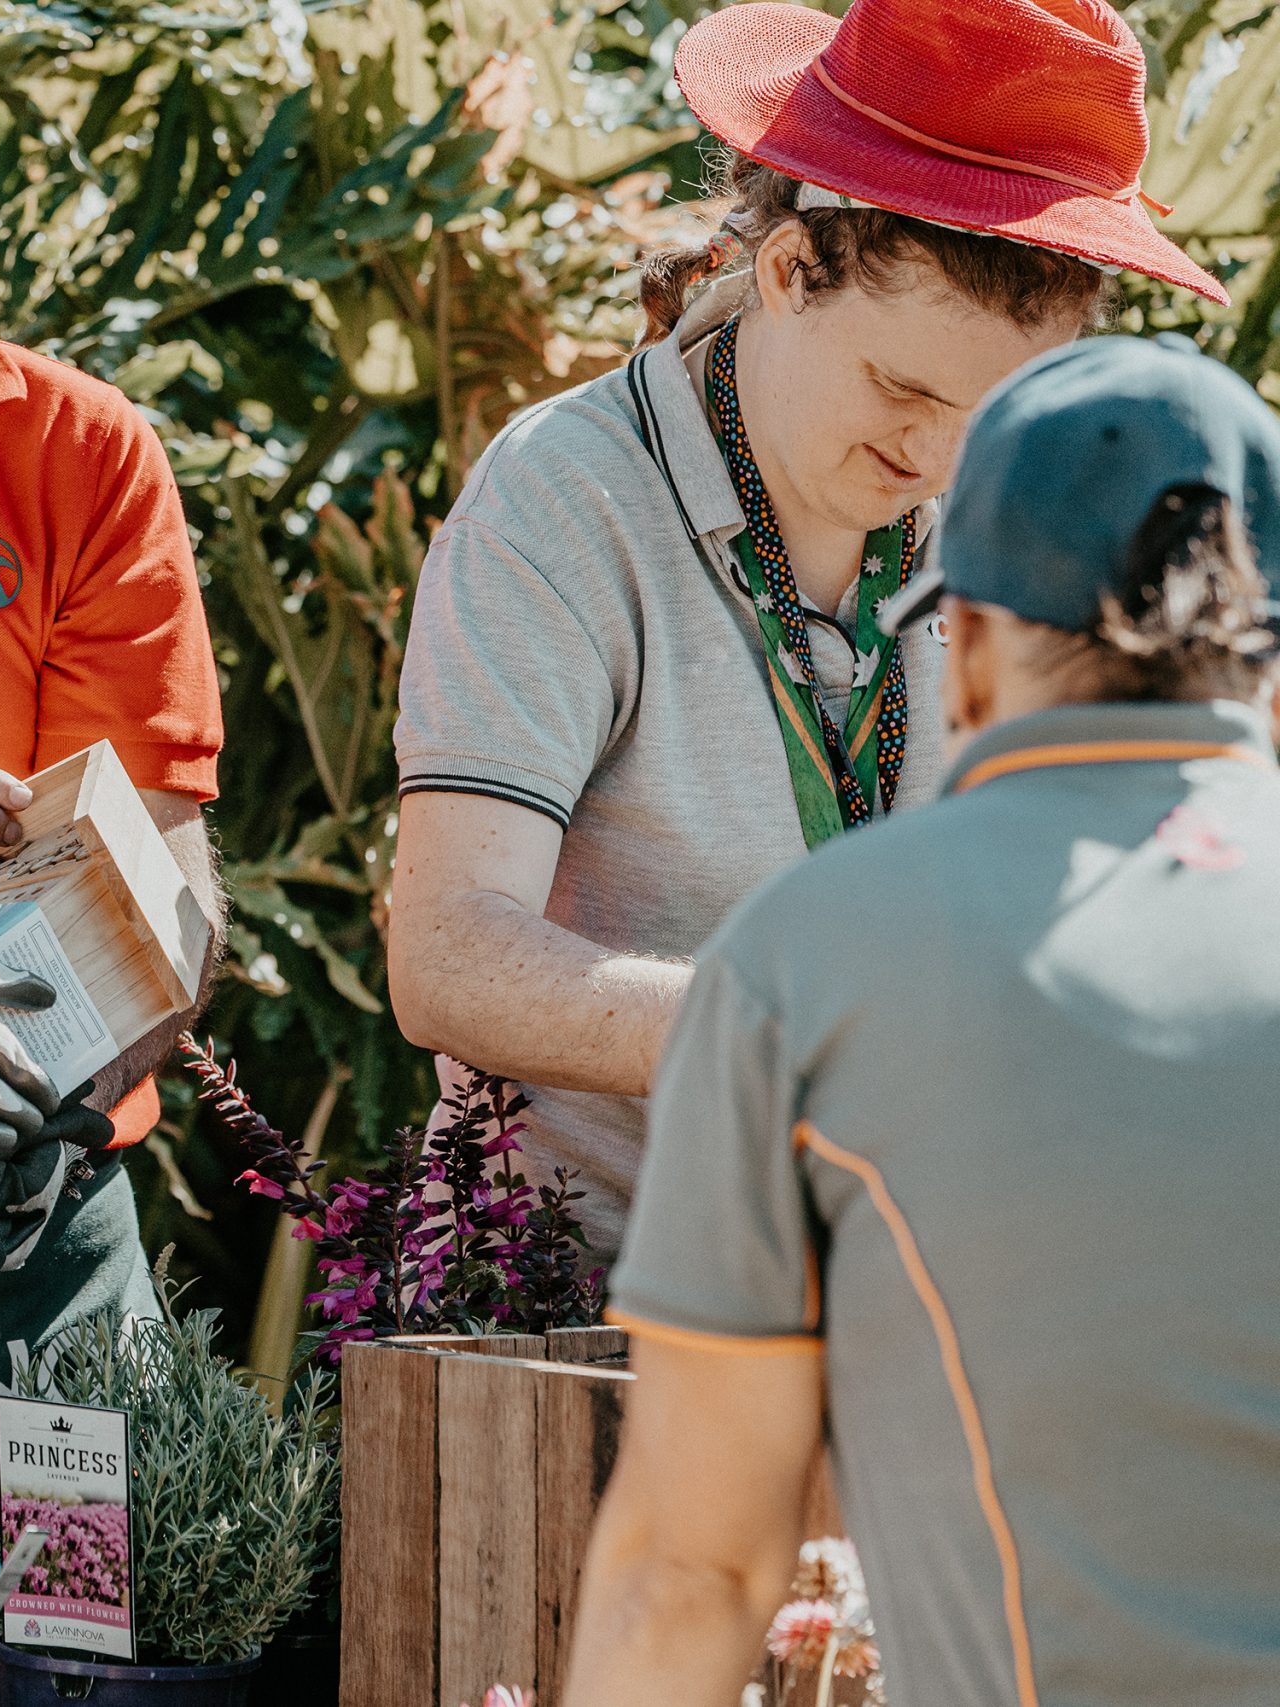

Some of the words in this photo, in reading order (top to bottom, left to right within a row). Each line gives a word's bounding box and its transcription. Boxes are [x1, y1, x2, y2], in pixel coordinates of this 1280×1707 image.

[49, 959, 60, 973] DID
[56, 972, 68, 988] YOU
[65, 987, 81, 1010] KNOW
[44, 1029, 63, 1058] providing
[55, 1436, 69, 1445] THE
[8, 1440, 118, 1477] PRINCESS
[9, 1599, 56, 1611] CROWNED
[59, 1603, 83, 1614] WITH
[86, 1607, 126, 1622] FLOWERS
[45, 1625, 105, 1642] LAVINNOVA
